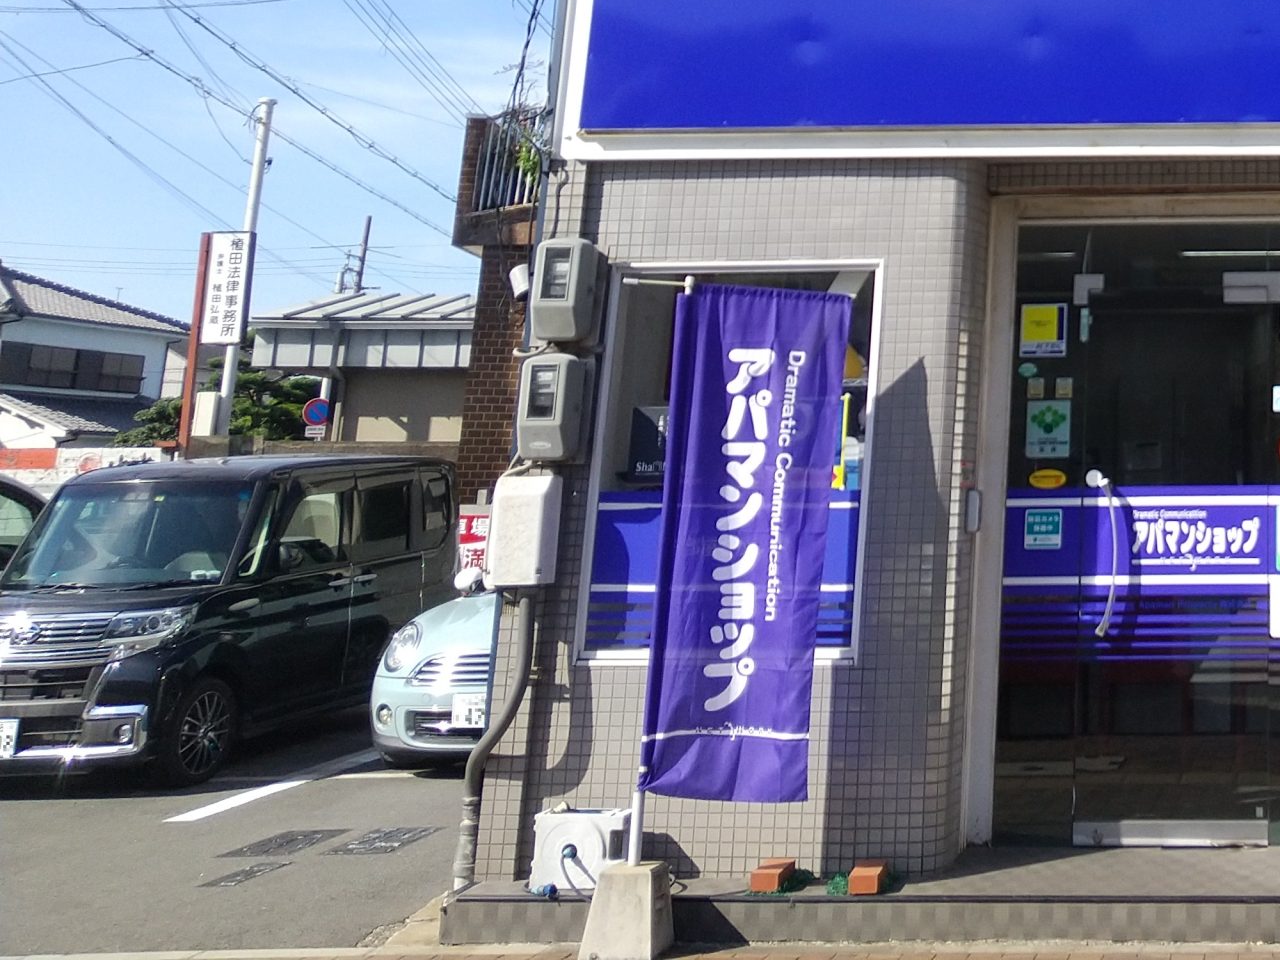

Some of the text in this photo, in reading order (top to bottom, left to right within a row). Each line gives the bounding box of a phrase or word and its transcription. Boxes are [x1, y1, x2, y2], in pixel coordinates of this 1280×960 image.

[220, 238, 245, 337] 植田法律事務所
[702, 347, 777, 712] アパマンショップ
[764, 350, 807, 622] Dramatic Communication
[1132, 517, 1260, 554] アパマンショップ
